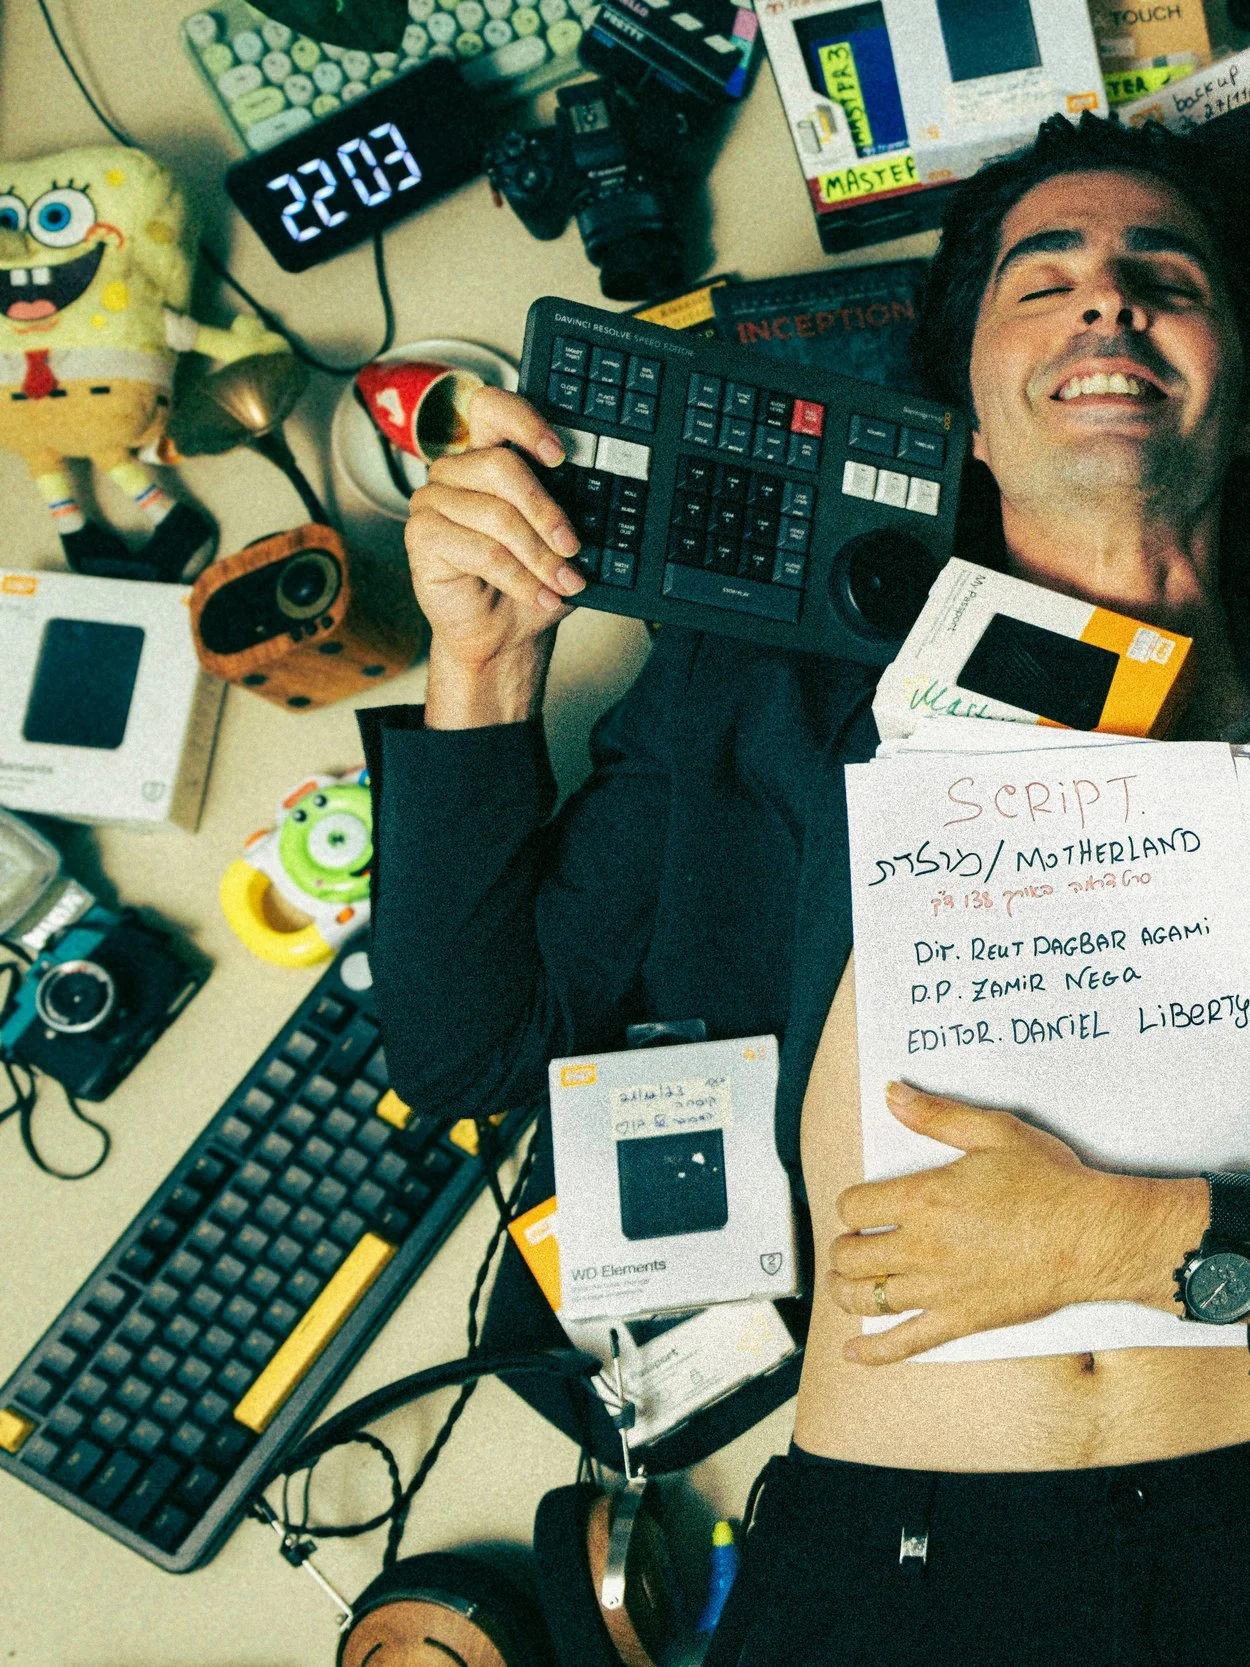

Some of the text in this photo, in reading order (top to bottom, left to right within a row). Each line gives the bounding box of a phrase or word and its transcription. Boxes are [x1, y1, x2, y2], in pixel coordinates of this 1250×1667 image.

[1111, 5, 1182, 26] TOUCH
[554, 312, 592, 329] DAVINCI
[592, 322, 632, 340] RESOLVE
[737, 299, 915, 345] INCEPTION
[950, 573, 987, 633] My Passport
[964, 889, 994, 909] 138
[1033, 929, 1127, 957] DAGBAR
[571, 1260, 667, 1282] WD Elements
